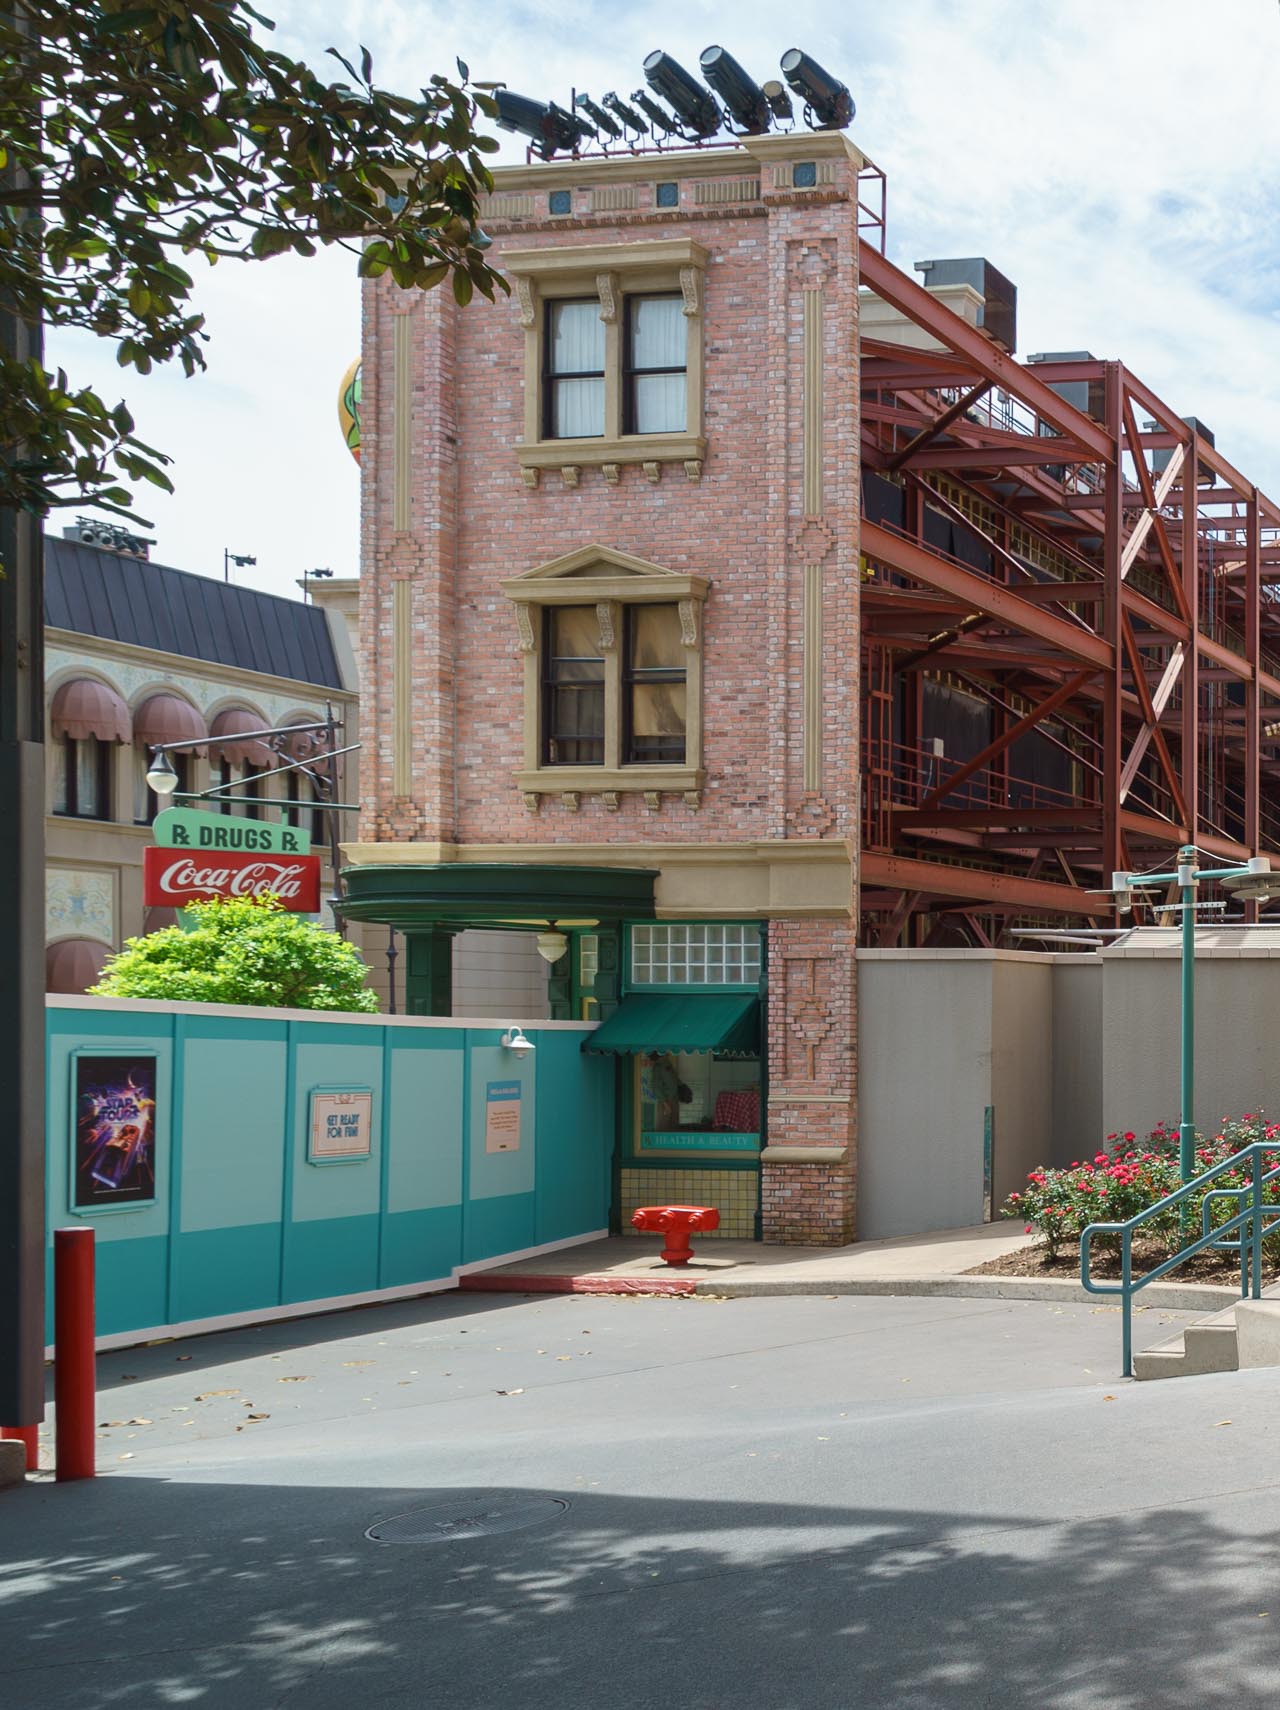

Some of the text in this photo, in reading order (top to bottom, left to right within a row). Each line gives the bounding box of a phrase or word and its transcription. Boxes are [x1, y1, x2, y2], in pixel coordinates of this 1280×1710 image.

[200, 826, 272, 850] DRUGS
[160, 859, 306, 898] Coca-Cola
[327, 1113, 360, 1126] GET READY
[327, 1127, 341, 1138] FOR
[655, 1135, 694, 1145] HEALTH
[697, 1136, 705, 1145] &
[709, 1136, 748, 1145] BEAUTY
